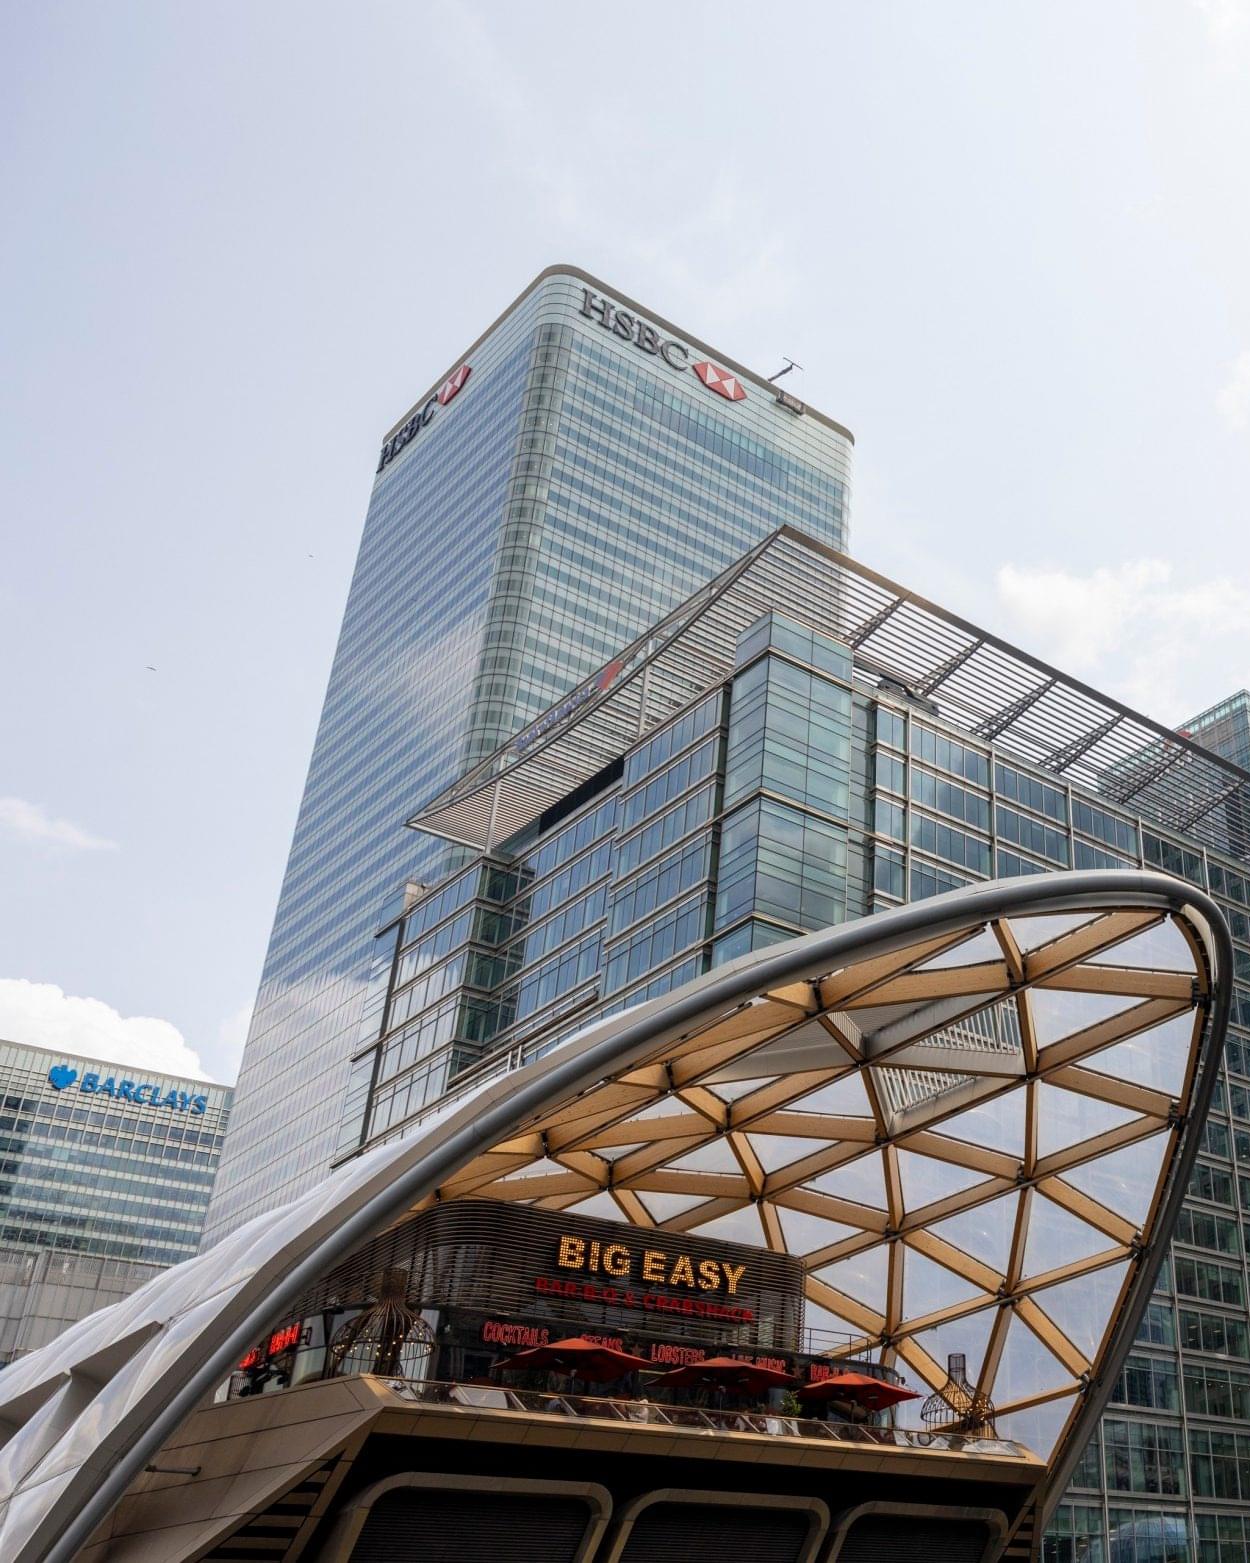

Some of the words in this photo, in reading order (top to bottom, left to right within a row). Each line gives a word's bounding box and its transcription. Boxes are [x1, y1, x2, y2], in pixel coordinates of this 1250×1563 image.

[578, 288, 689, 371] HSBC
[376, 393, 438, 472] HSBC
[80, 1072, 207, 1114] BARCLAYS
[558, 1235, 631, 1276] BIG
[642, 1250, 746, 1294] EASY
[482, 1320, 550, 1347] COCKTAILS
[651, 1343, 705, 1366] LOBSTERS
